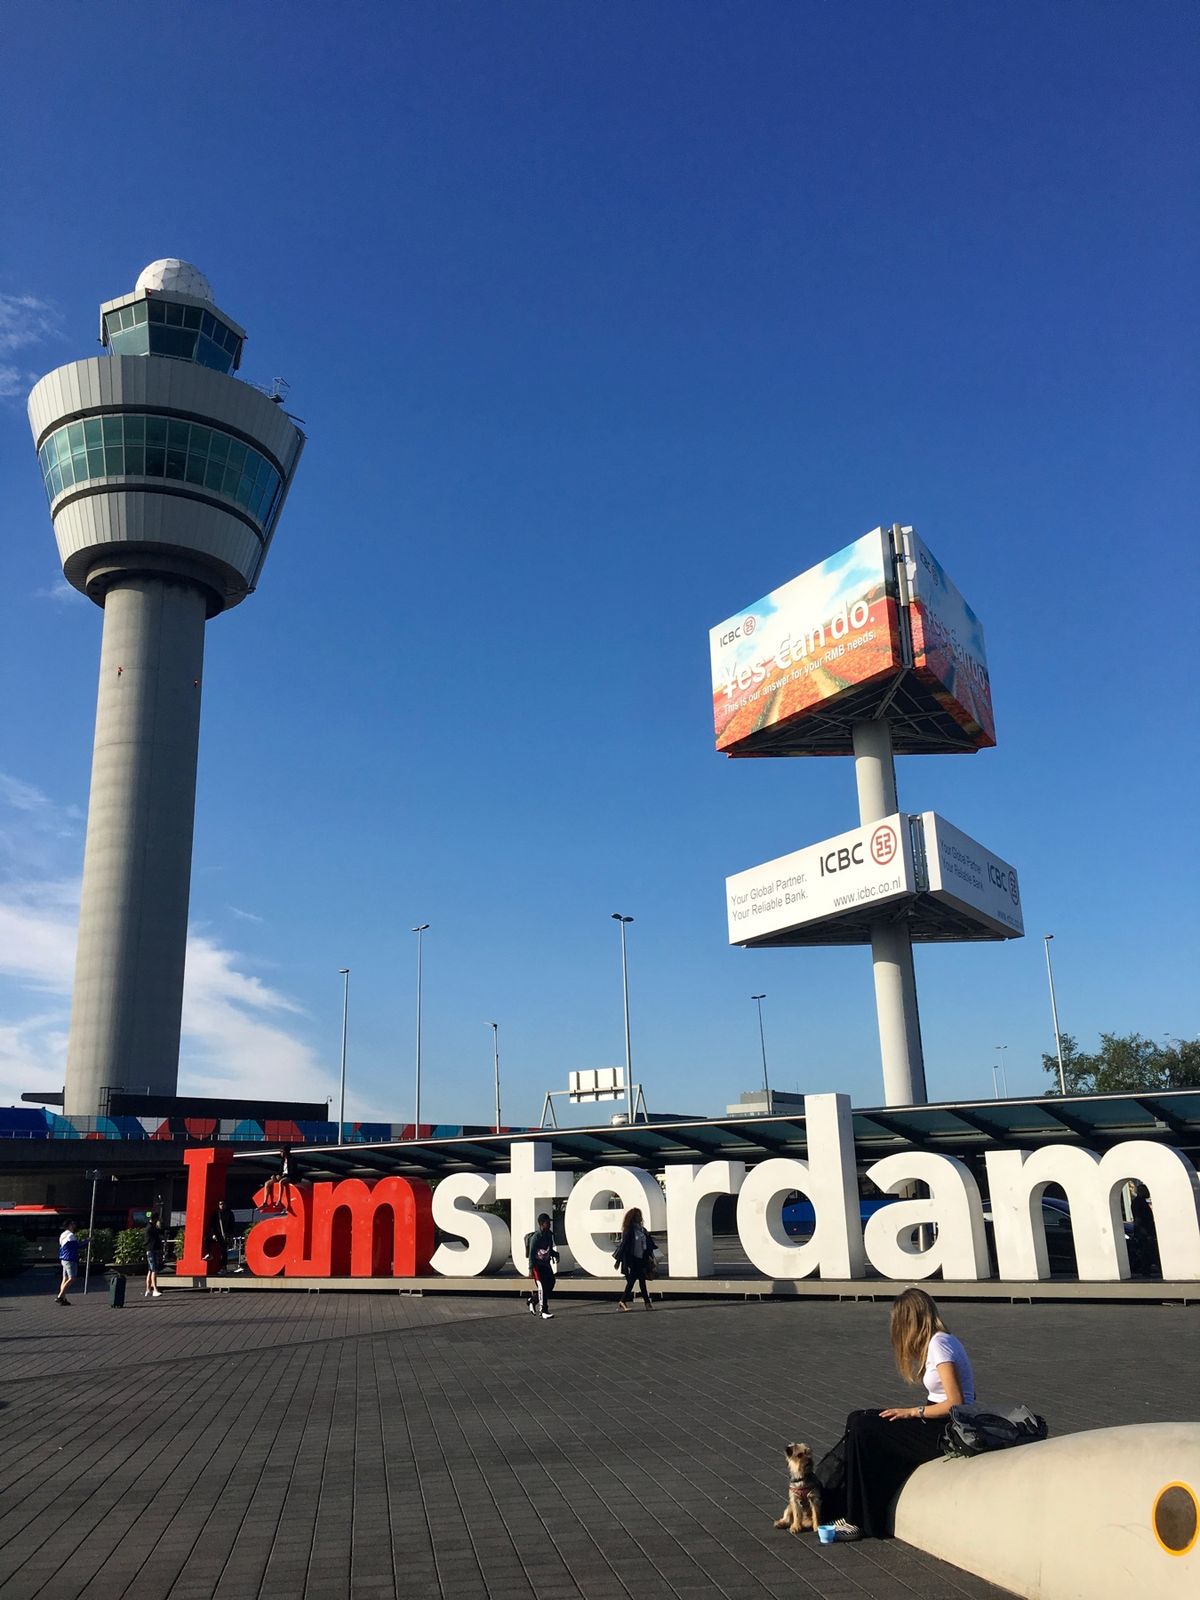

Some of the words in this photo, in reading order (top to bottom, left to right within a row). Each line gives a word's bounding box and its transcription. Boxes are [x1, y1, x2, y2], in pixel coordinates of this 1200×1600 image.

[831, 599, 876, 639] do.
[719, 626, 741, 648] ICBC
[723, 700, 739, 715] This
[750, 689, 762, 702] our
[762, 677, 790, 696] answer
[791, 669, 804, 681] for
[804, 658, 823, 674] your
[825, 646, 845, 662] RMB
[847, 630, 877, 651] needs.
[819, 842, 865, 877] ICBC
[731, 893, 749, 906] Your
[750, 881, 775, 900] Global
[776, 873, 808, 891] Partner.
[833, 876, 901, 907] www.icbc.co.nl
[987, 861, 1008, 892] ICBC
[732, 908, 750, 922] Your
[751, 896, 783, 916] Reliable
[785, 889, 809, 905] Bank.
